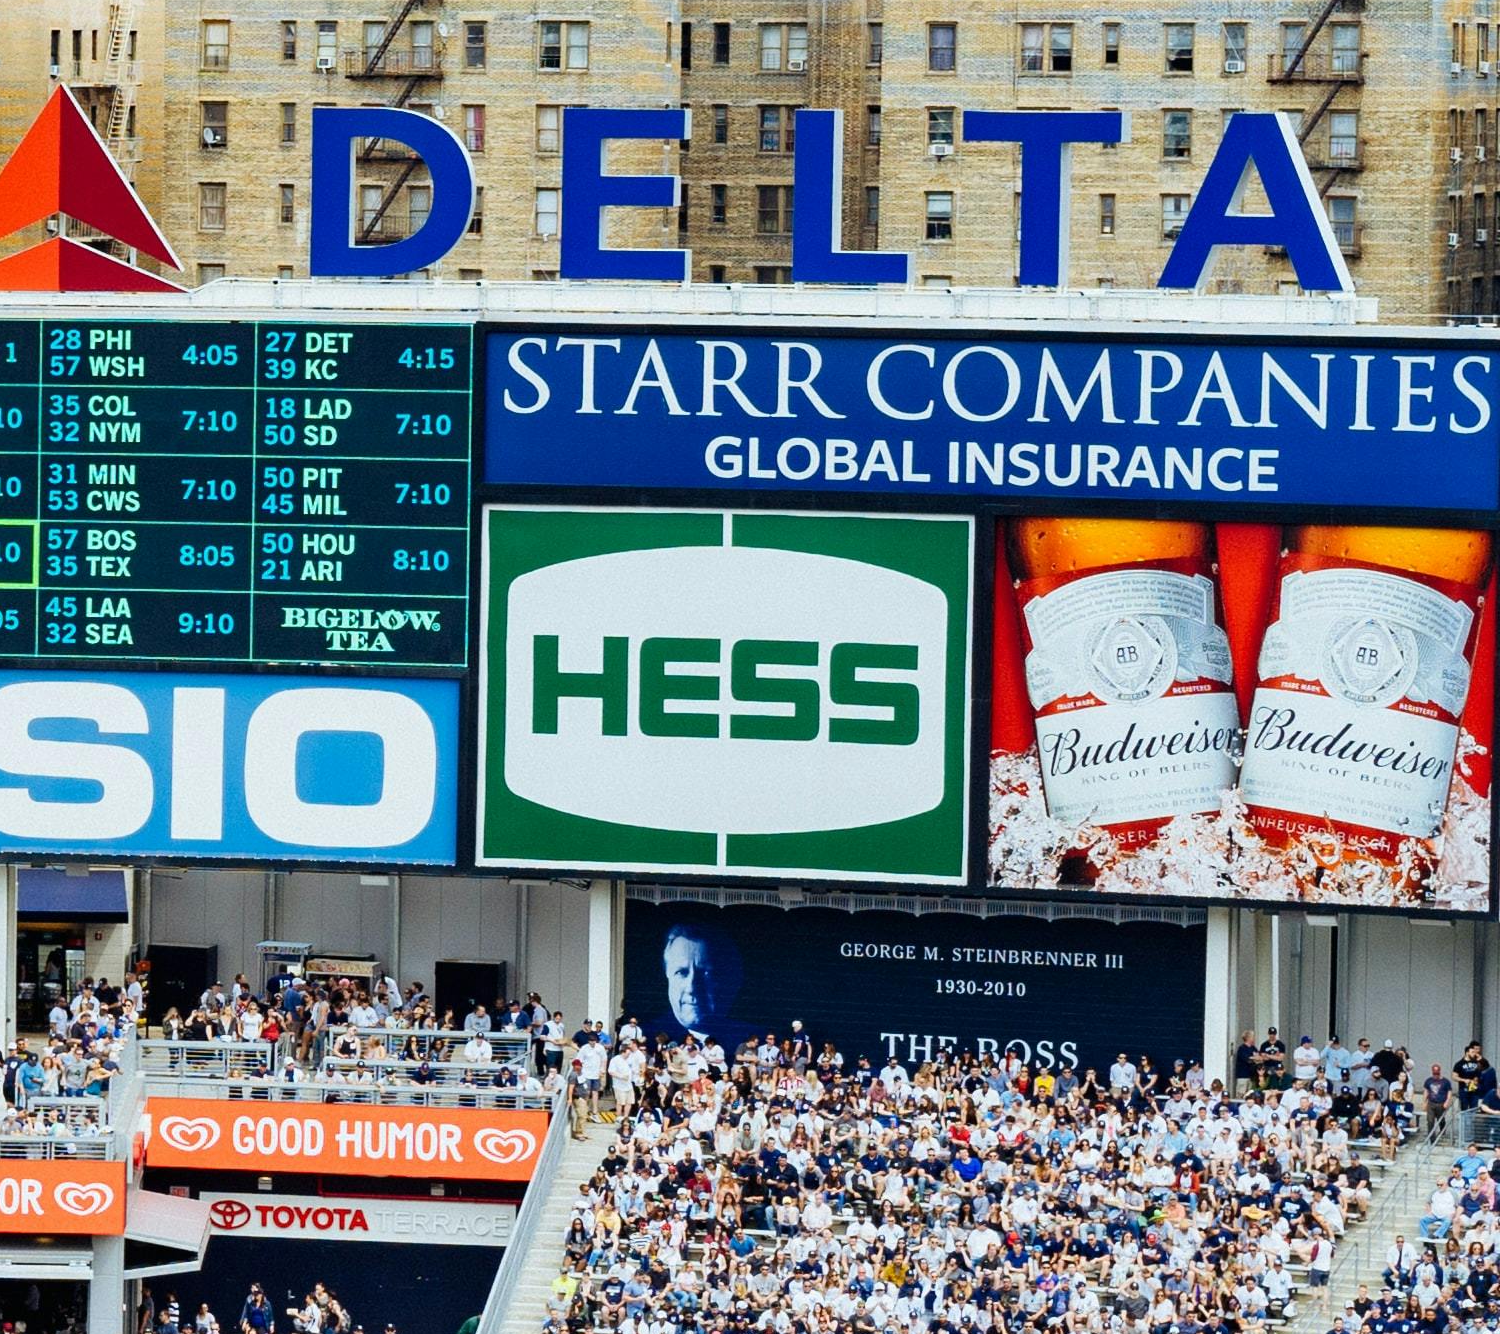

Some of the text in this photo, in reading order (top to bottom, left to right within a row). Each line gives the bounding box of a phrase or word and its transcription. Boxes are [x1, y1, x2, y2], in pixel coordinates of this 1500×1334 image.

[308, 106, 1355, 292] DELTA
[503, 338, 1493, 437] STARR COMPANIES
[705, 434, 1278, 494] GLOBAL INSURANCE
[281, 607, 440, 630] BIGELOW
[326, 631, 394, 651] TEA
[534, 630, 920, 744] HESS
[1044, 720, 1239, 777] Budweiser
[1253, 706, 1449, 780] Budweiser
[840, 943, 1123, 968] GEORGE M. STEINBRENNER III
[935, 979, 1026, 997] 1930-2010
[233, 1116, 463, 1162] GOOD HUMOR
[256, 1205, 510, 1238] TOYOTA TERRACE
